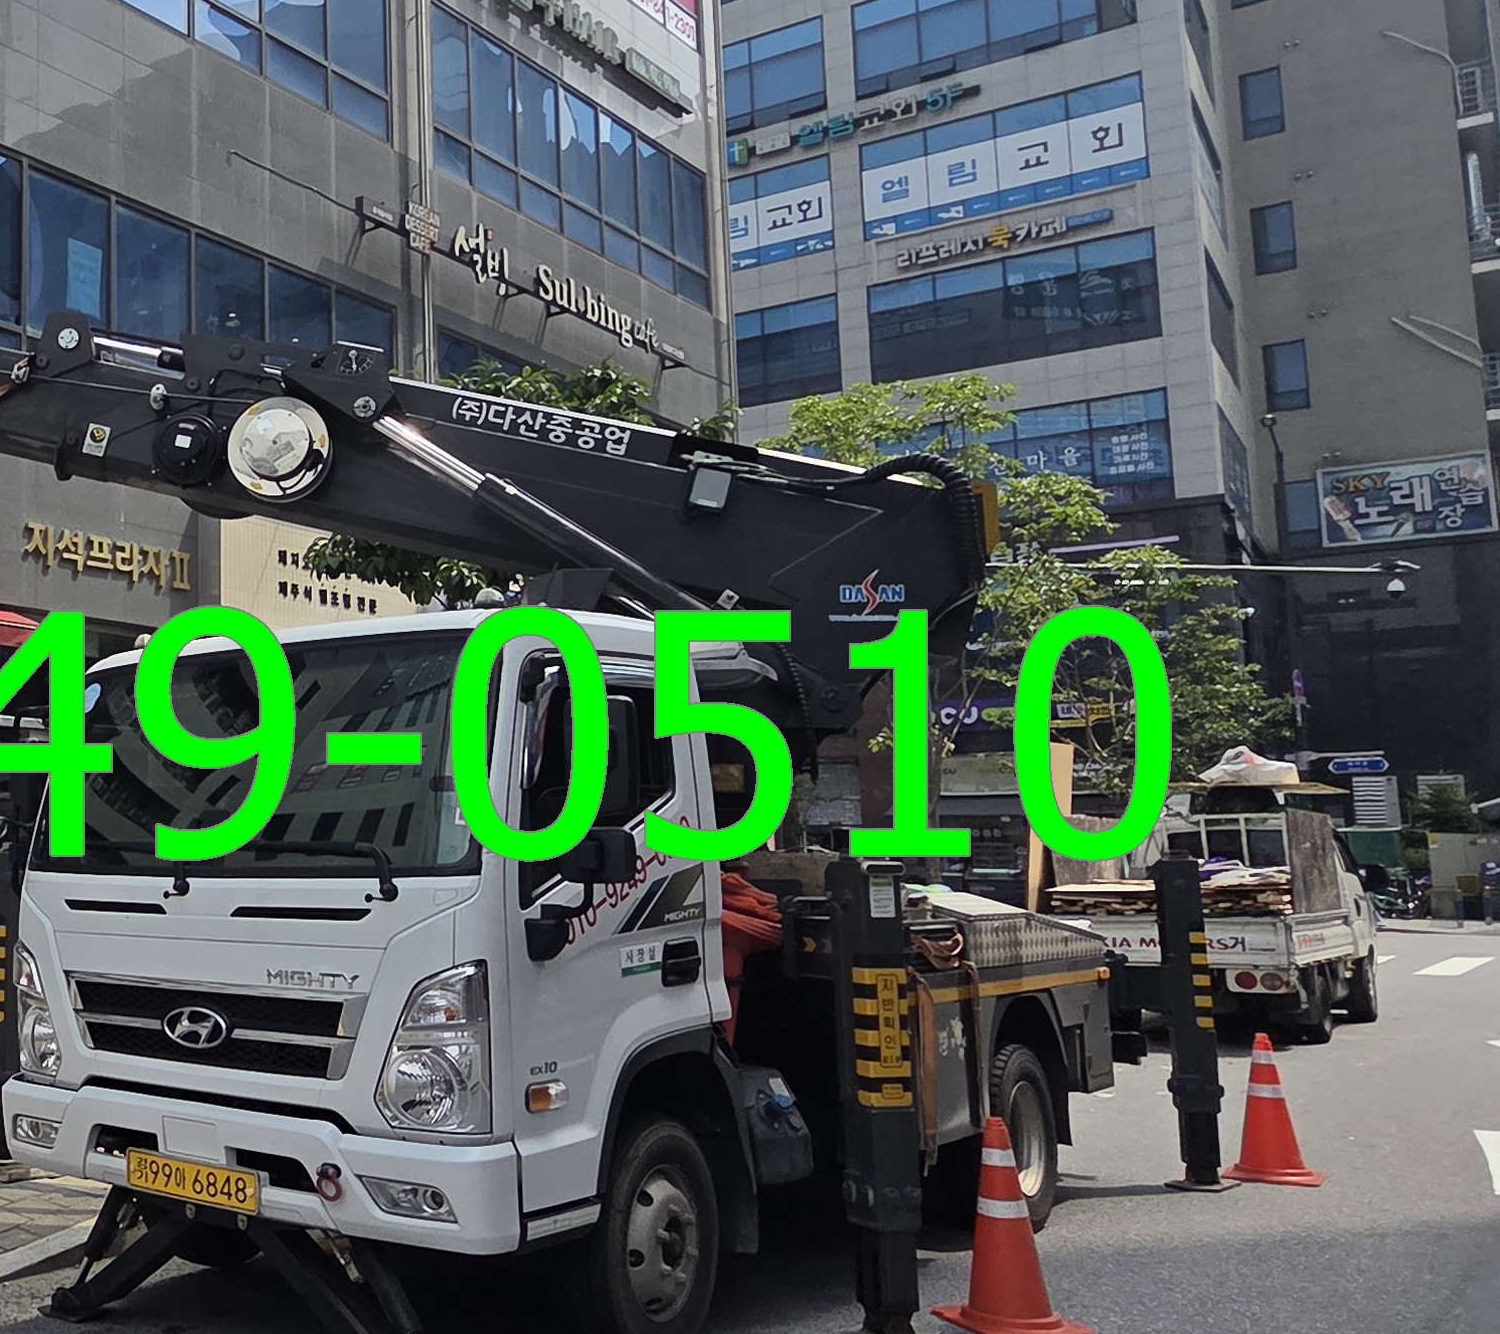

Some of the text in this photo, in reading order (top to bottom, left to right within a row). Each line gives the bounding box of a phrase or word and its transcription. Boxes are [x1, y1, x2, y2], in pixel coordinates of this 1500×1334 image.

[799, 94, 918, 148] 엘림교회
[924, 82, 964, 113] 5F
[880, 121, 1124, 204] 엘림교회
[405, 213, 440, 242] DESSERT
[407, 199, 441, 227] KOREAN
[409, 230, 432, 255] CAFE
[454, 222, 510, 296] 설빙
[633, 317, 659, 354] cafe
[451, 396, 632, 457] (주)다산중공업
[1331, 470, 1391, 496] SKY
[23, 522, 169, 590] 지석프라자
[839, 568, 906, 617] DASAN
[939, 706, 979, 726] CU
[663, 907, 700, 923] MIGHTY
[1101, 936, 1132, 949] KIA
[266, 968, 360, 990] MIGHTY
[149, 1159, 187, 1191] 99아
[191, 1168, 248, 1204] 6848
